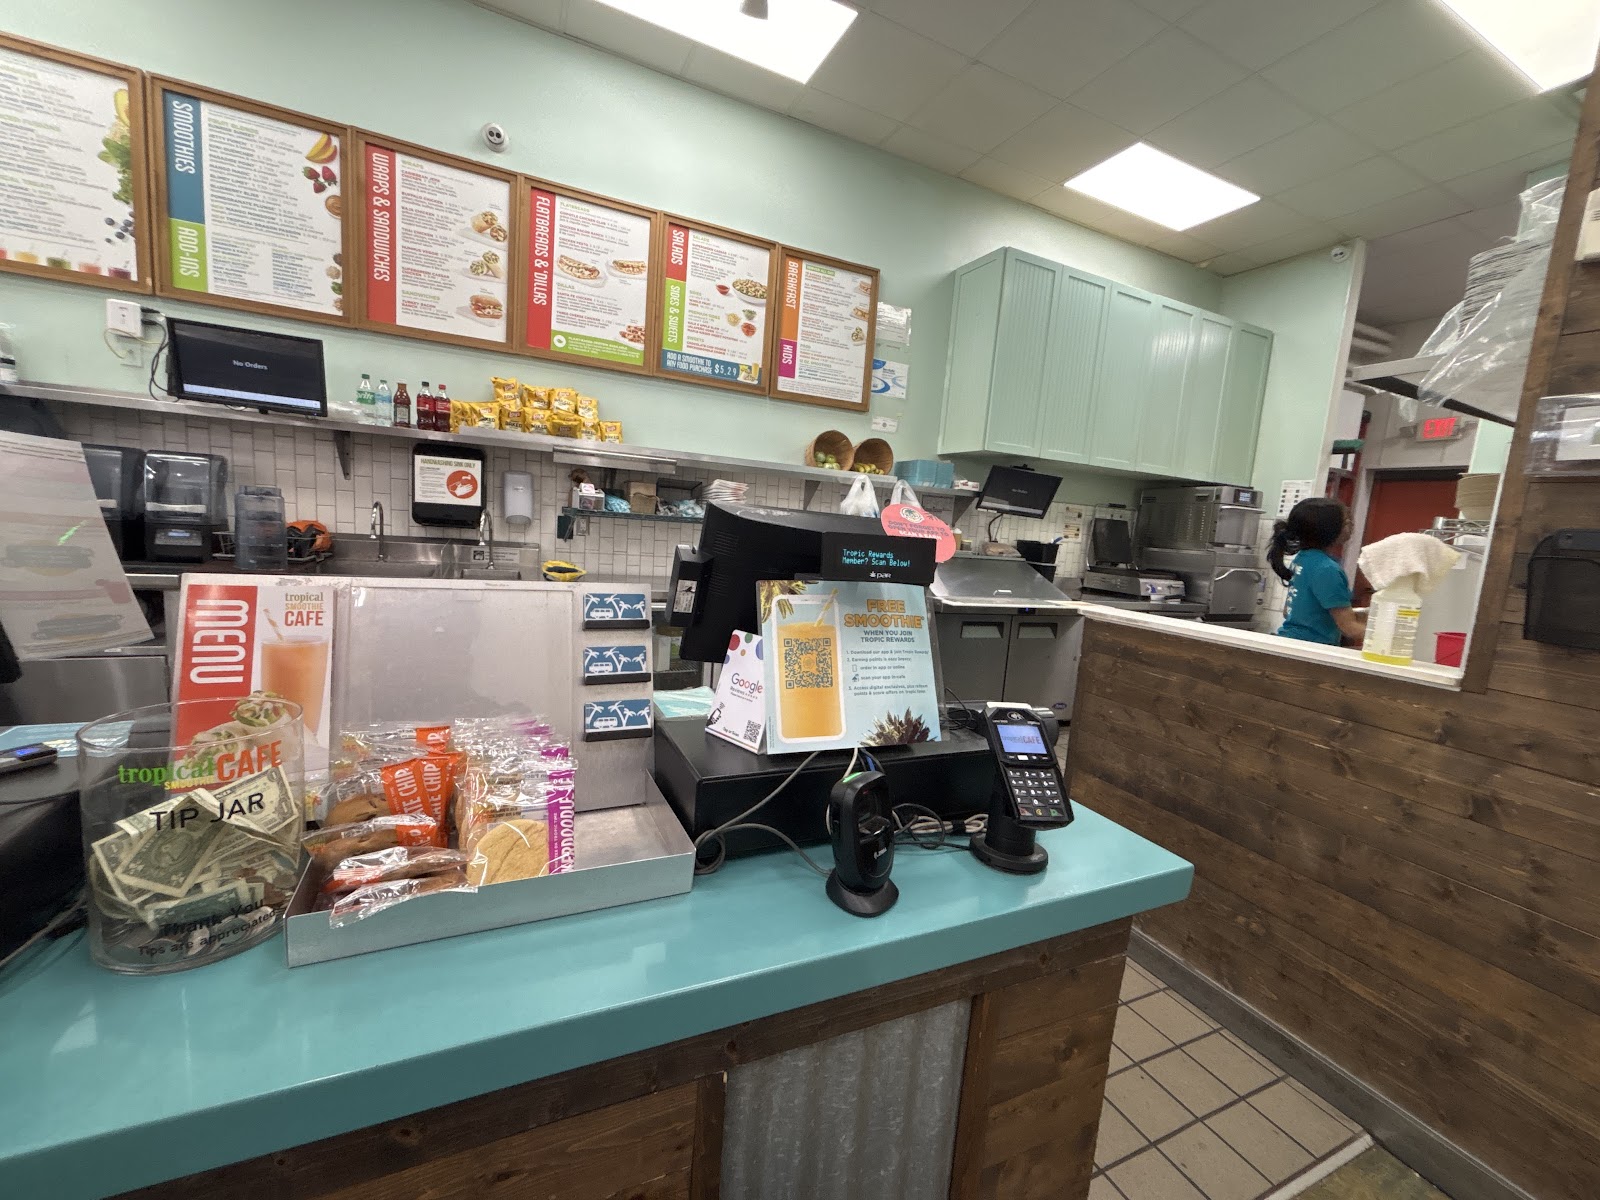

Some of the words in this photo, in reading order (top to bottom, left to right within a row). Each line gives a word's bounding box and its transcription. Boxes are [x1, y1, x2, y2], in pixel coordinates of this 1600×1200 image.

[172, 100, 195, 174] SMOOTHIES
[372, 152, 390, 195] WRAPS
[373, 197, 391, 207] &
[534, 195, 550, 257] FLATBREADS
[177, 227, 199, 277] ADD-INS
[373, 209, 390, 281] SANDWICHES
[671, 229, 685, 266] SALADS
[534, 259, 549, 268] &
[669, 285, 681, 306] SIDES
[785, 260, 799, 310] BREAKFAST
[667, 316, 679, 343] SWEETS
[232, 359, 244, 367] No
[244, 360, 269, 371] Orders
[666, 351, 677, 360] ADD
[682, 353, 705, 366] SMOOTHIE
[705, 359, 712, 367] TO
[781, 344, 794, 365] KIDS
[666, 359, 677, 367] ANY
[677, 361, 689, 370] FOOD
[690, 362, 713, 374] PURCHASE
[714, 363, 737, 376] $5.29
[420, 458, 453, 467] HANDWASHING
[842, 549, 865, 557] Tropic
[868, 550, 894, 559] Rewards
[842, 557, 869, 565] Member?
[871, 558, 887, 566] Scan
[889, 559, 911, 568] Below!
[285, 592, 324, 602] tropical
[285, 602, 324, 610] SMOOTHIE
[866, 599, 906, 613] FREE
[284, 610, 324, 627] CAFE
[189, 598, 250, 684] MENU
[863, 629, 884, 637] WHEN
[885, 629, 899, 637] YOU
[731, 672, 763, 694] Google
[118, 757, 214, 787] tropical
[216, 740, 282, 781] CAFE
[394, 767, 418, 797] CHIP
[423, 763, 441, 792] CHIP
[149, 807, 199, 831] TIP
[210, 792, 264, 823] JAR
[139, 944, 166, 957] Tips
[171, 941, 193, 953] are
[200, 909, 276, 946] appreciated
